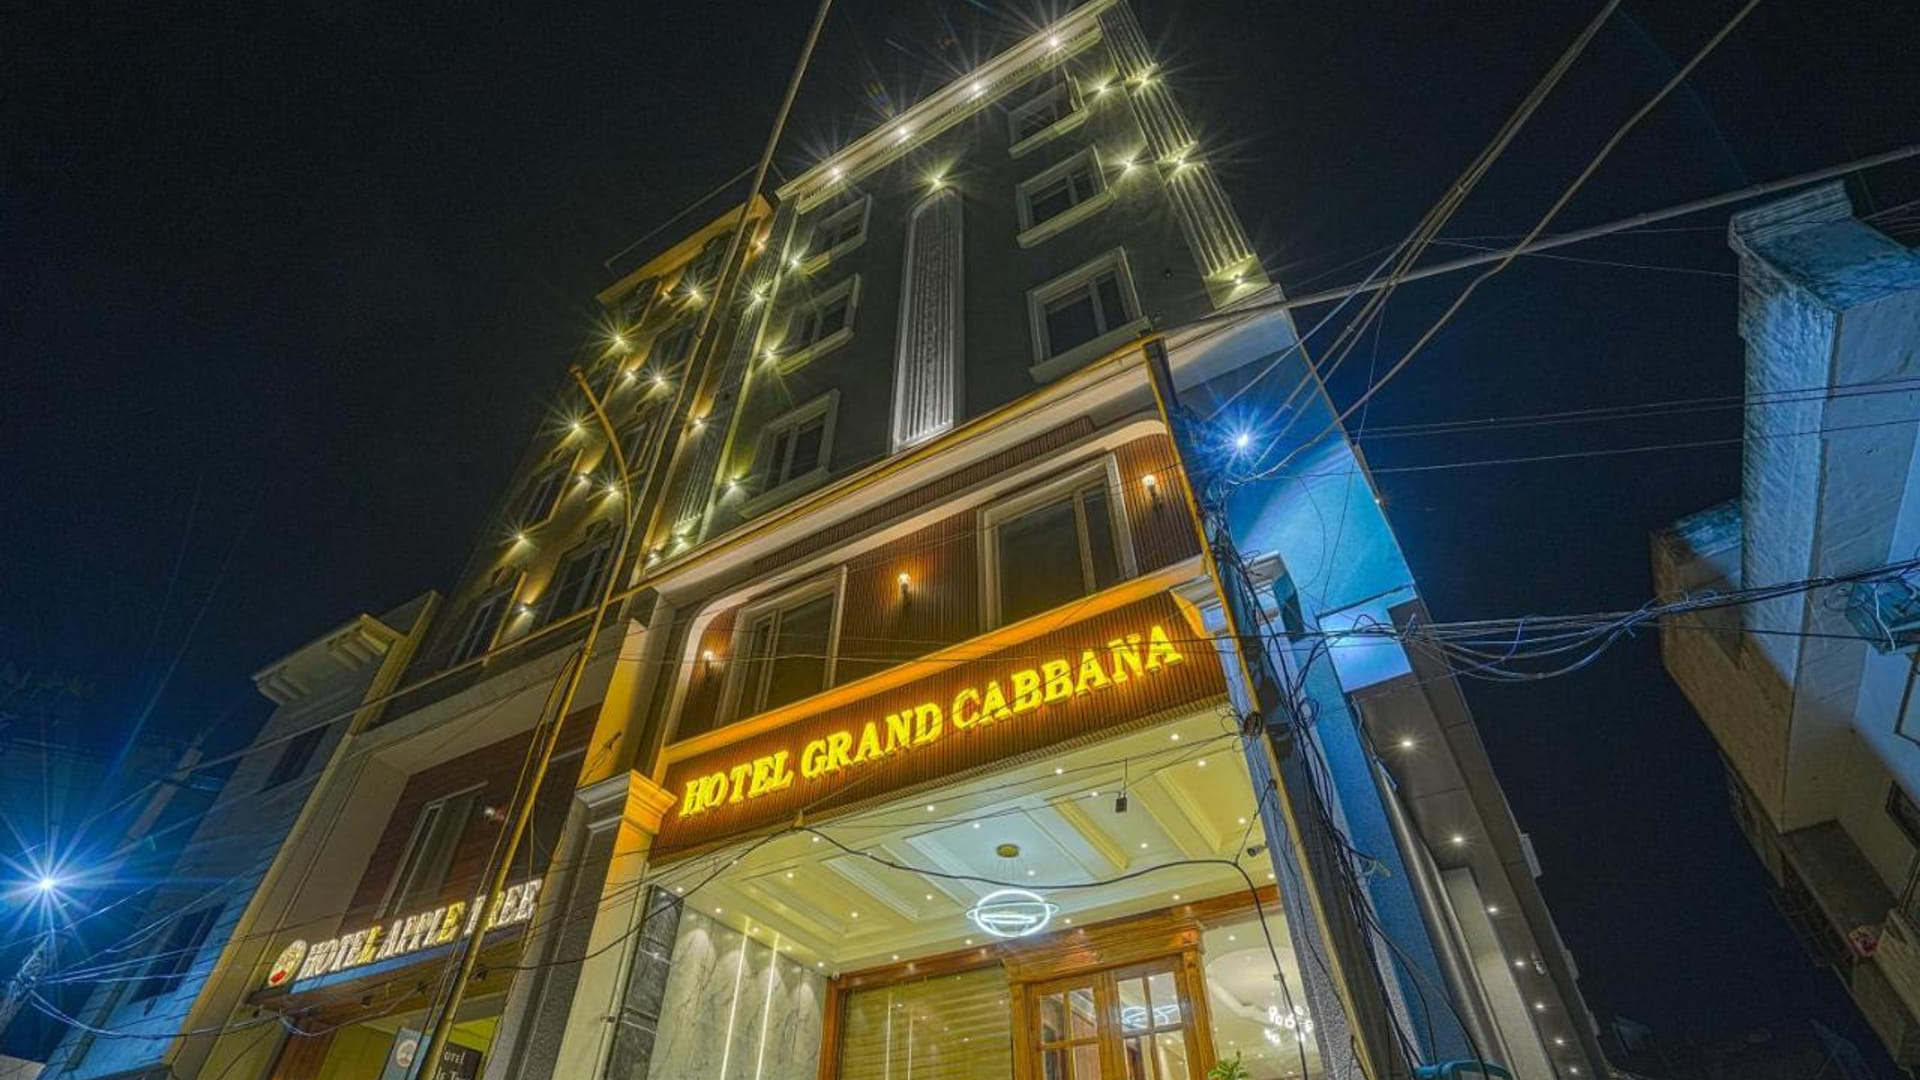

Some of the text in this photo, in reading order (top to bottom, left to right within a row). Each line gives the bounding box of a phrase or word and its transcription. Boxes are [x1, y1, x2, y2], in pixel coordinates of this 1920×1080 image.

[679, 625, 1183, 819] HOTEL GRAND CABBANA
[295, 926, 382, 981] HOTEL
[375, 901, 466, 960] APPLE
